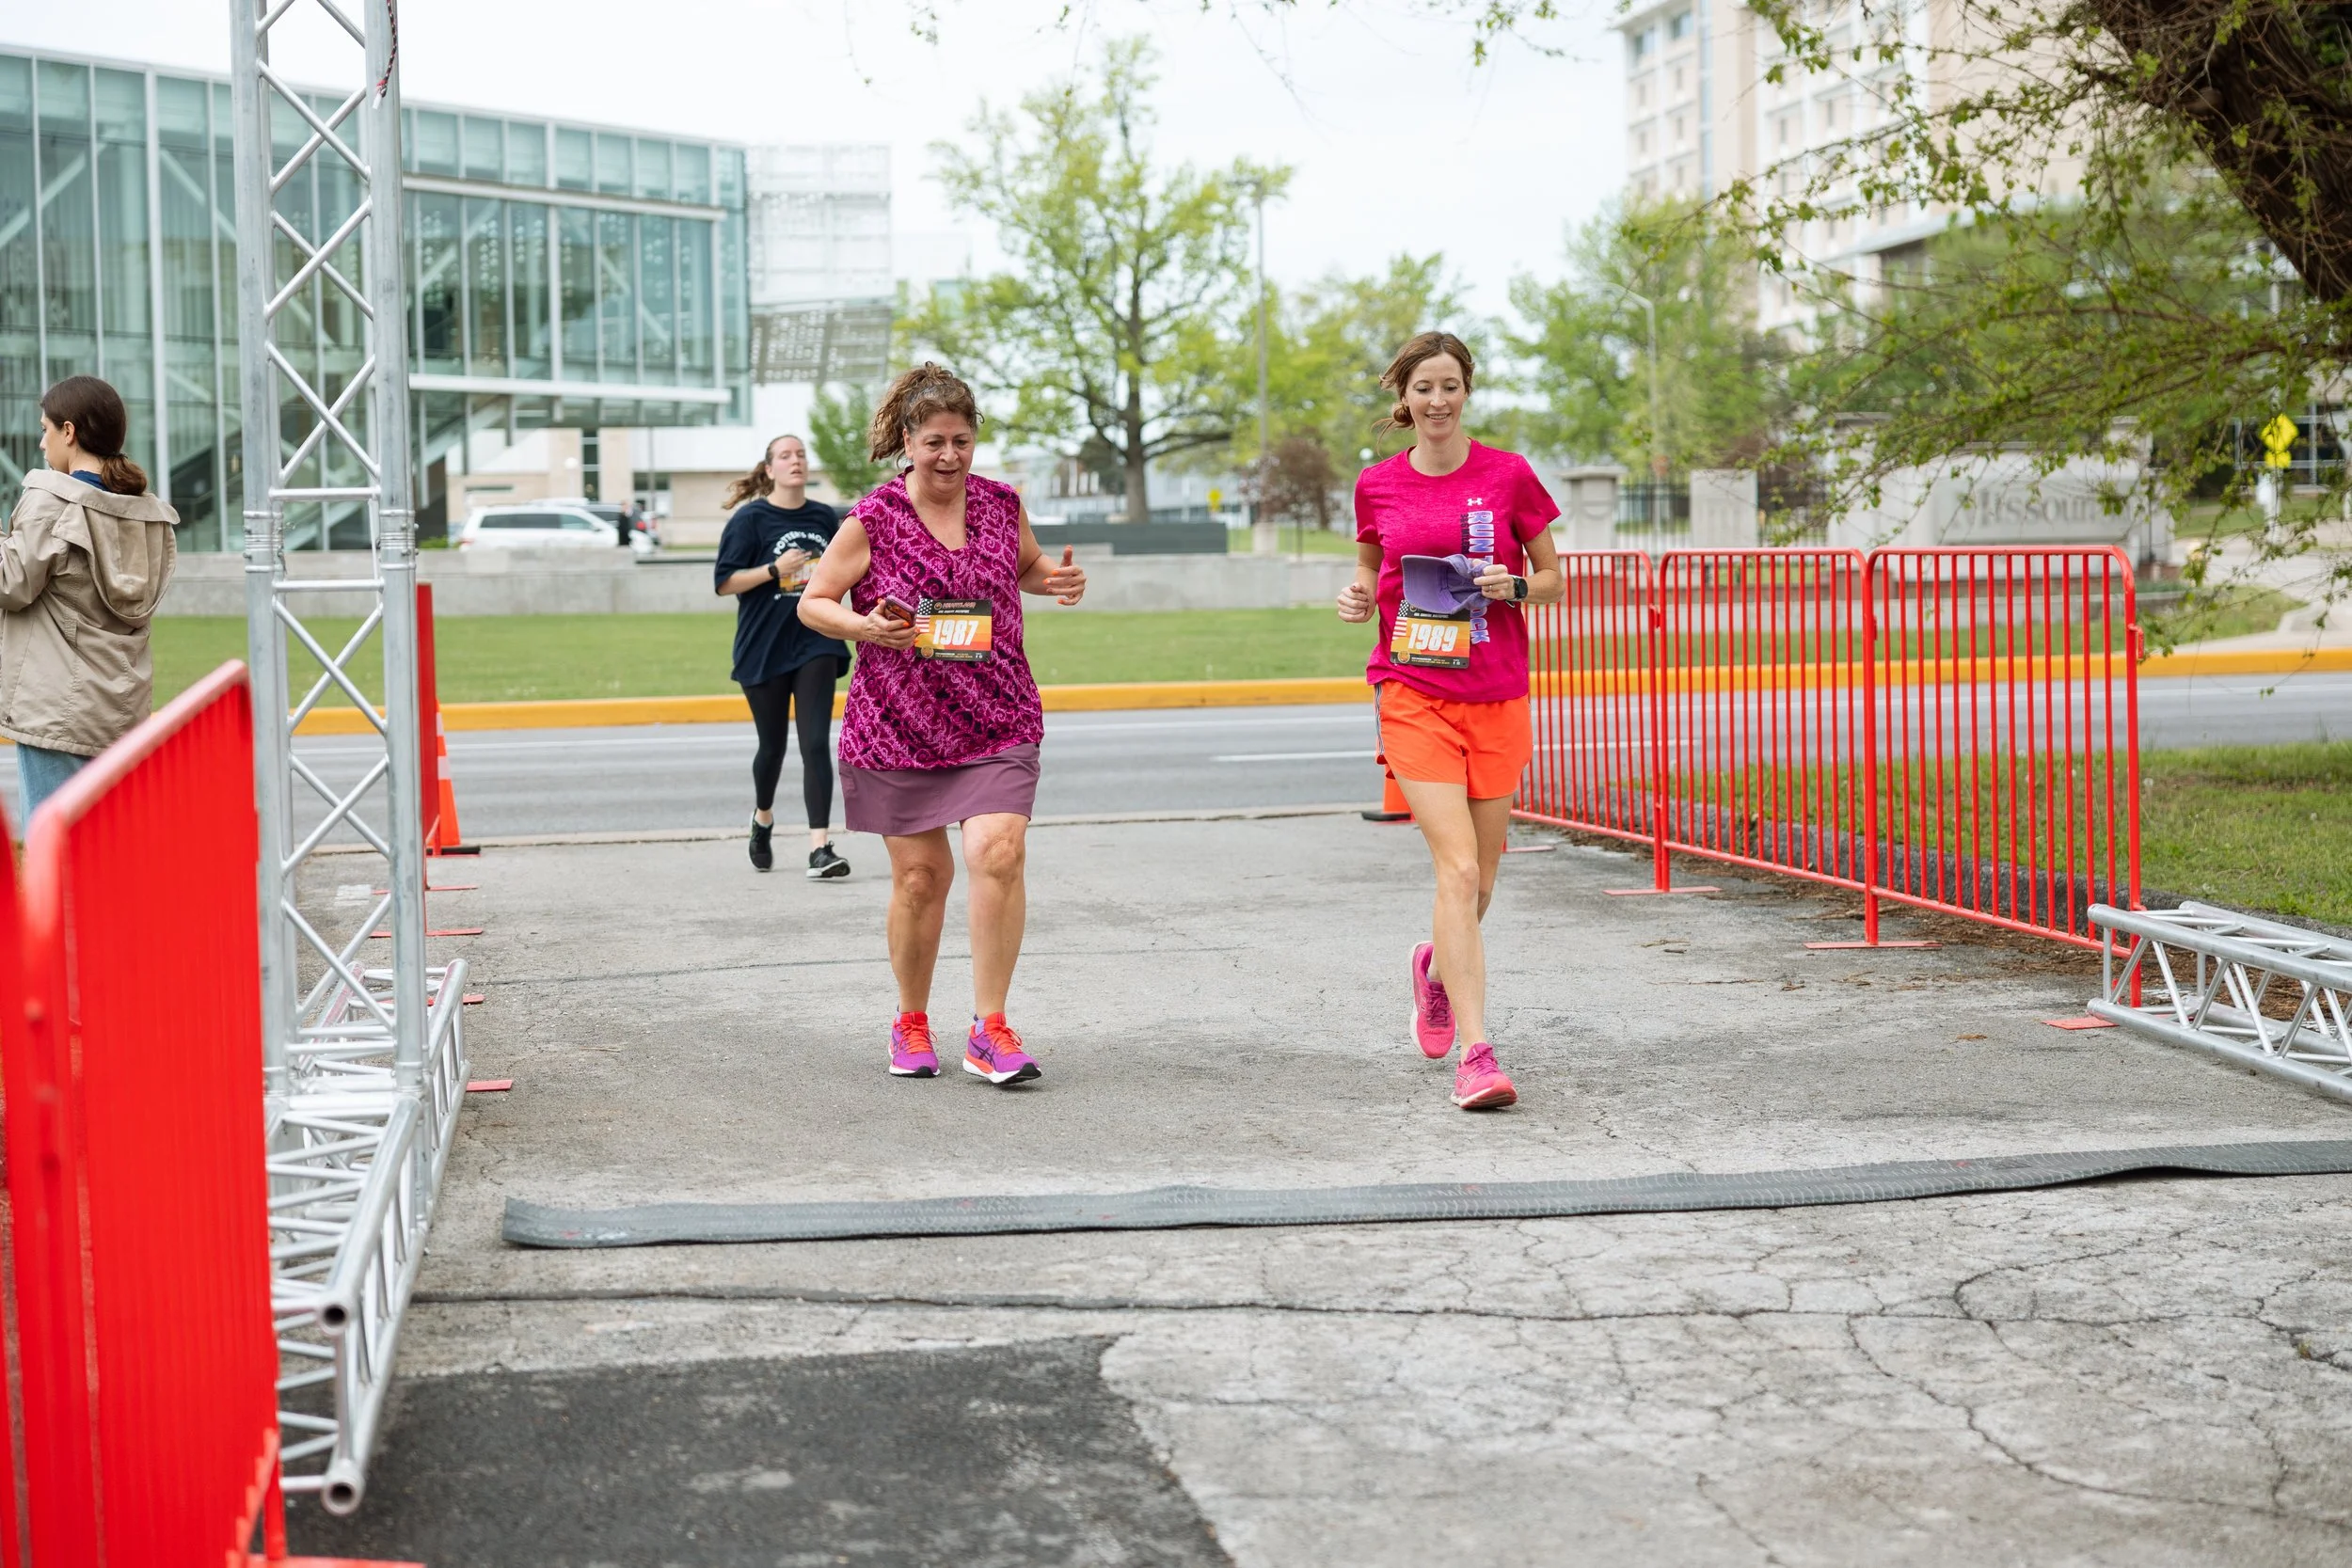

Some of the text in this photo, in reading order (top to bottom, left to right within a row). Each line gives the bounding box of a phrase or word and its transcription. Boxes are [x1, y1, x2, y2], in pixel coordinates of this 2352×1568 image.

[808, 533, 828, 549] HOU
[1468, 511, 1494, 552] RUN
[932, 619, 978, 646] 1987
[1408, 623, 1458, 652] 1989
[1470, 607, 1490, 644] OCK
